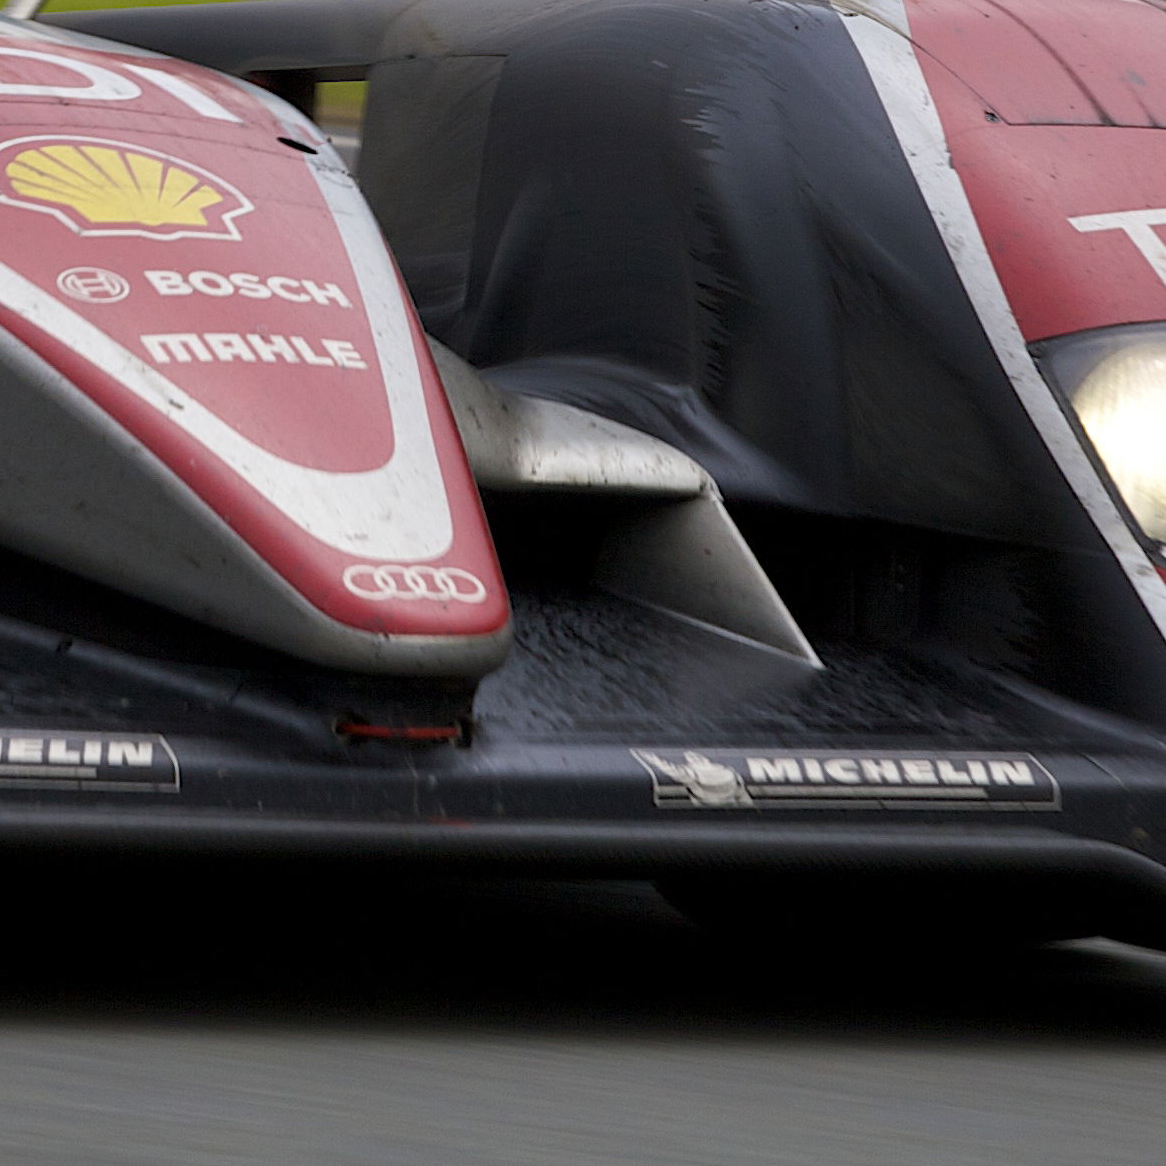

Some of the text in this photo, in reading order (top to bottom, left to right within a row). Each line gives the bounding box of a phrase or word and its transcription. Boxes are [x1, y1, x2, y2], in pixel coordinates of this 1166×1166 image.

[143, 269, 353, 309] BOSCH
[140, 332, 368, 371] MAHLE
[745, 757, 1035, 786] MICHELIN
